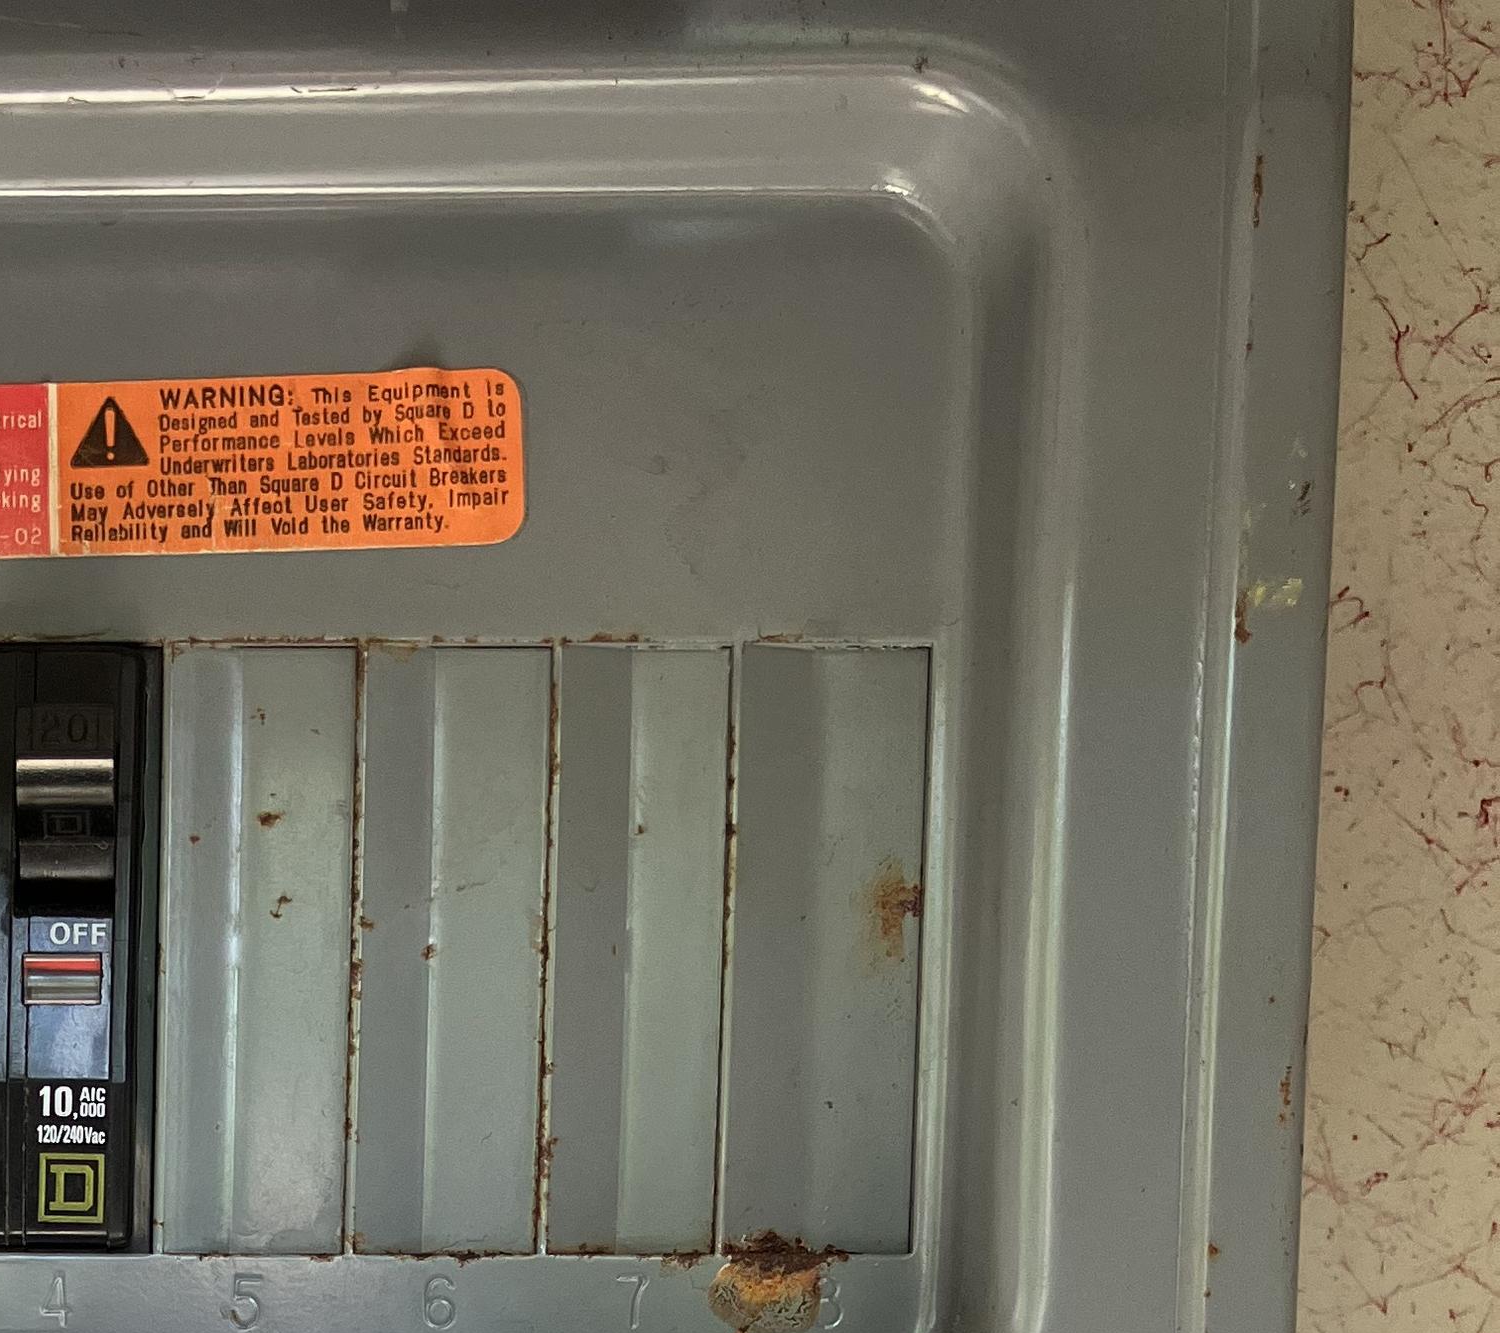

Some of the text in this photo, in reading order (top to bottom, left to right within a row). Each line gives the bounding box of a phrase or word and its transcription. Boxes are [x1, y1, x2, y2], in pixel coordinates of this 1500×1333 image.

[159, 384, 293, 410] WARNING:
[311, 387, 351, 404] This
[368, 382, 471, 404] Equipment
[158, 399, 506, 435] Designed and Tested by Square D to
[160, 421, 505, 453] Performance Levels Which Exceed
[160, 444, 507, 475] Underwriters Laboratories Standards.
[70, 467, 506, 500] Use of Other Than Square D Circuit Breakers
[71, 503, 108, 525] May
[122, 500, 215, 520] Adversely
[230, 496, 292, 516] Affect
[305, 495, 348, 513] User
[449, 488, 509, 510] Impair
[72, 513, 449, 543] Reliability and Will Void the Warranty.
[49, 922, 107, 945] OFF
[79, 1087, 105, 1102] AIC
[40, 1270, 71, 1329] 4
[229, 1274, 263, 1331] 5
[422, 1276, 457, 1330] 6
[615, 1276, 649, 1330] 7
